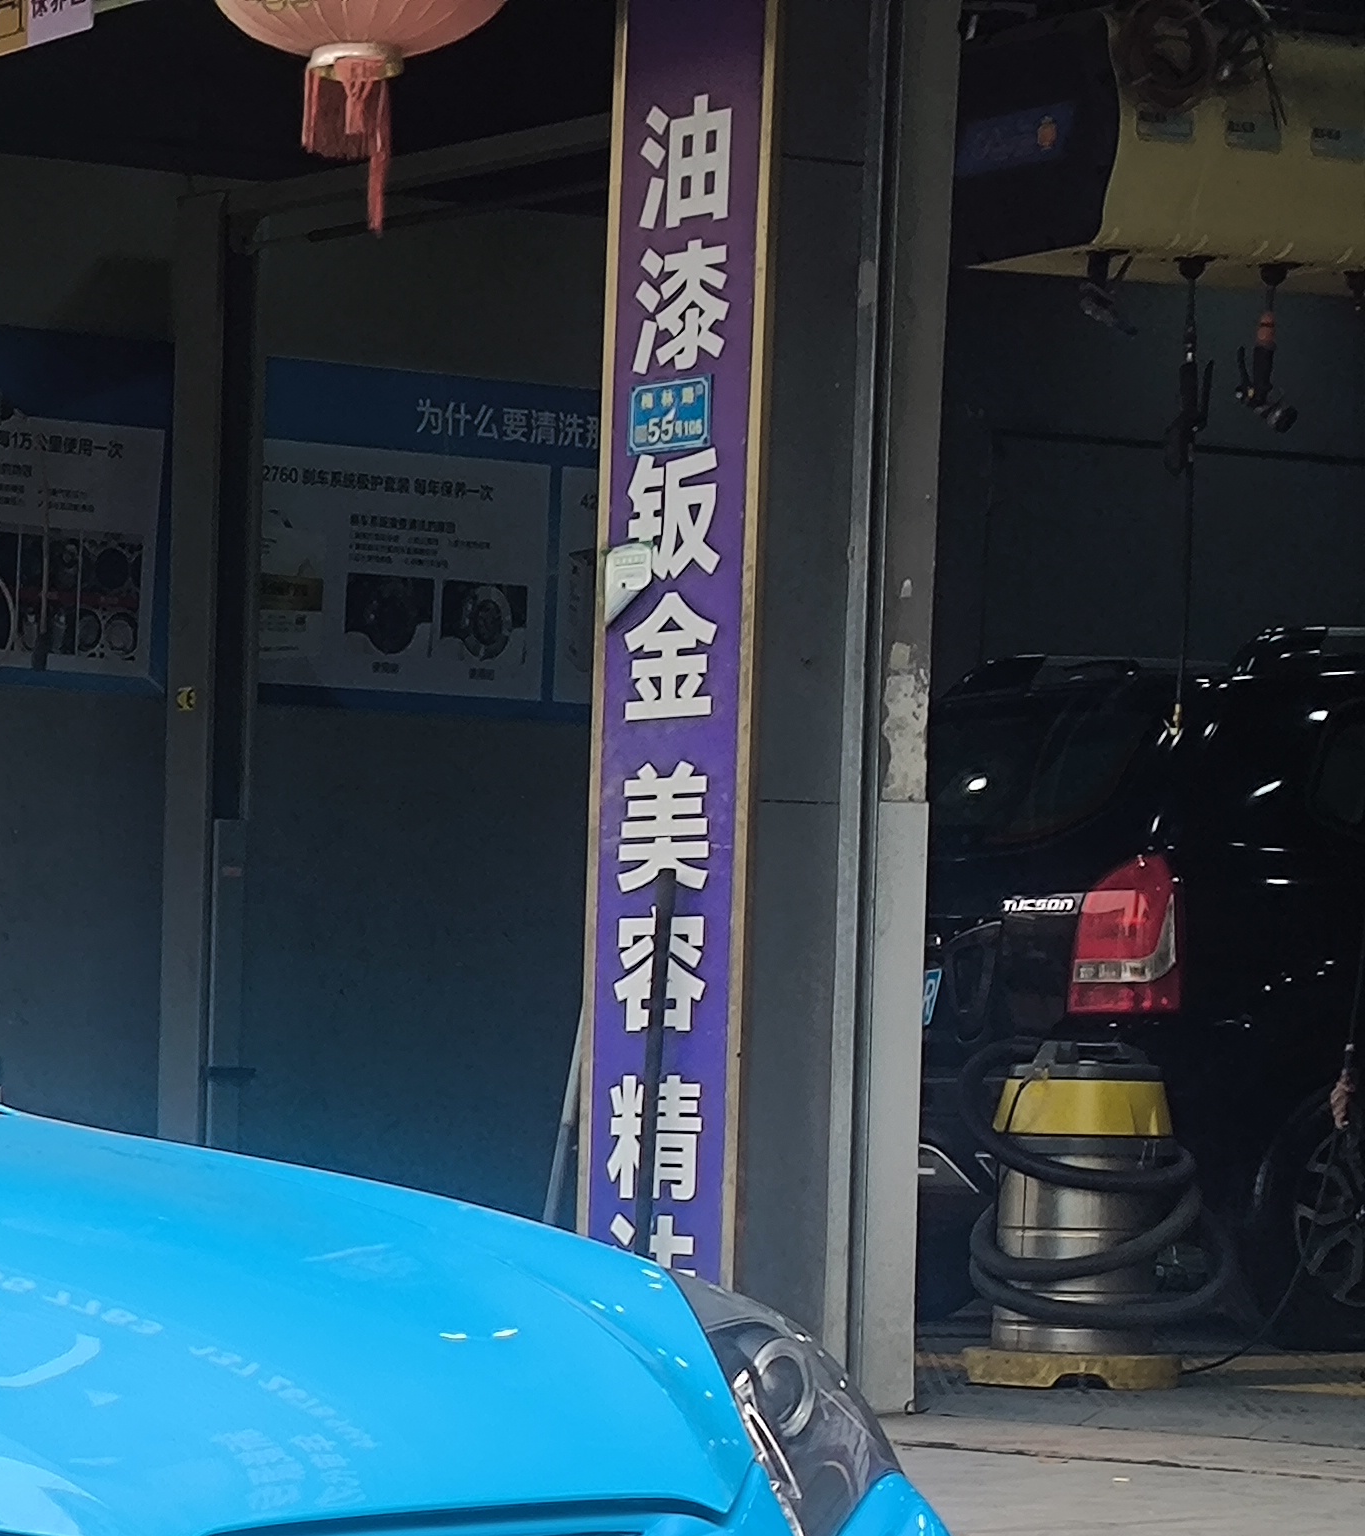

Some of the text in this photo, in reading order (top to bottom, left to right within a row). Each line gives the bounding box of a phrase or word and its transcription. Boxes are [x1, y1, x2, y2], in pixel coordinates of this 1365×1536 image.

[623, 93, 735, 721] 油漆钣金
[613, 760, 712, 1033] 美容
[1001, 897, 1074, 913] TUCSON
